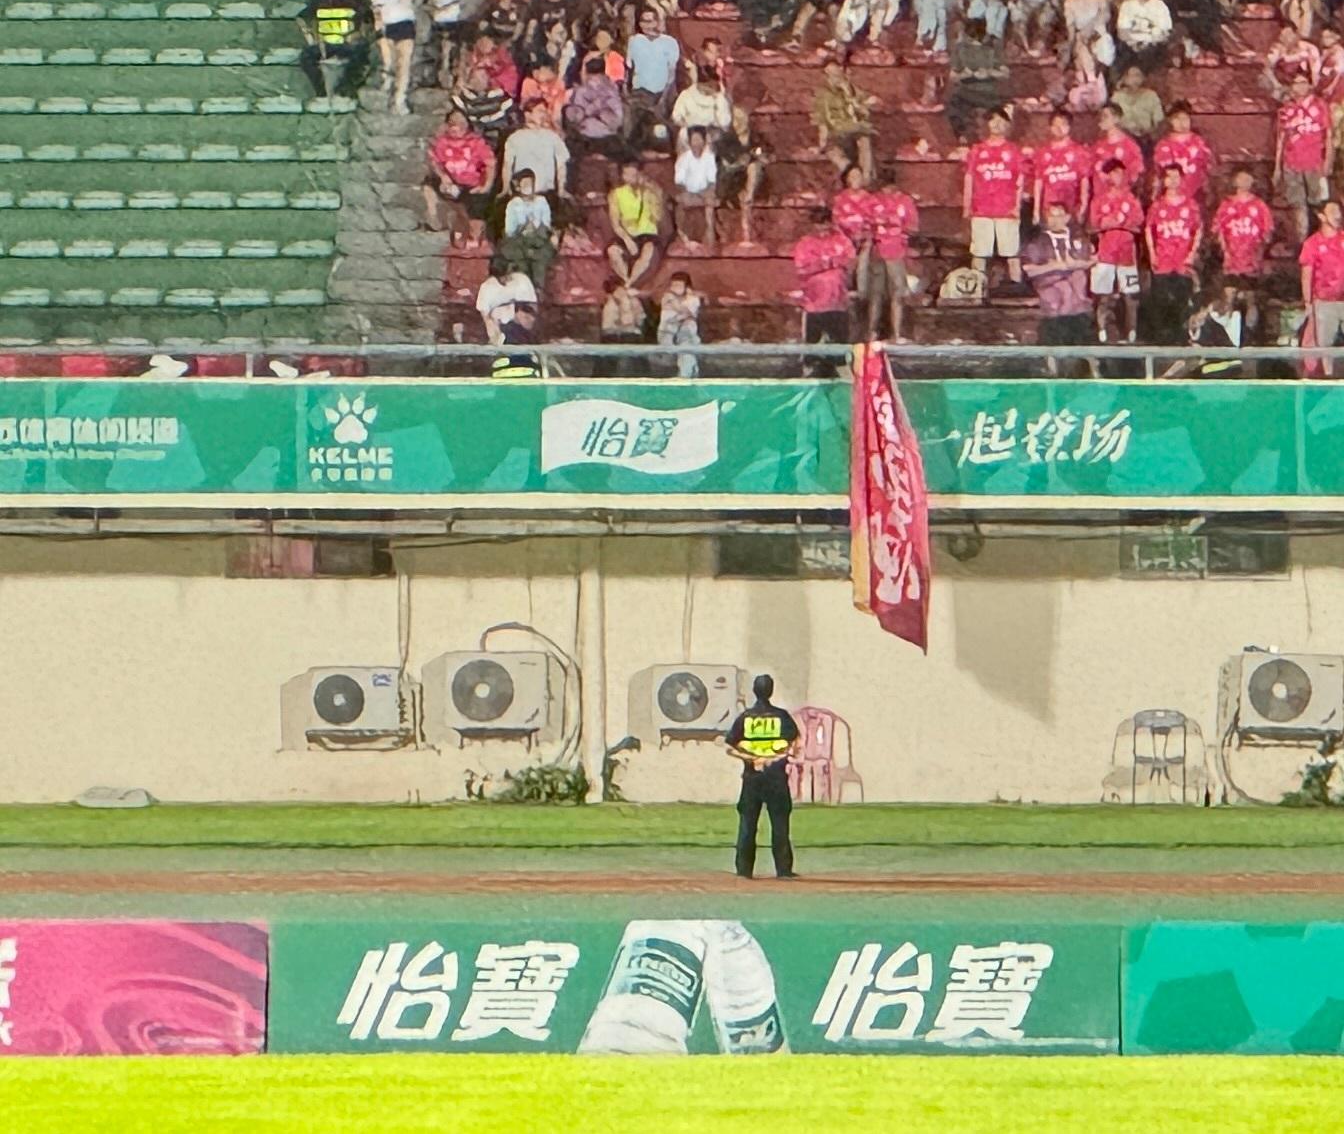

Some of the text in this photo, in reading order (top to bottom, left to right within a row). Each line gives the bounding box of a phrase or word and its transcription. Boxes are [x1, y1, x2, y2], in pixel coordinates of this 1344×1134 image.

[309, 447, 393, 465] KELME
[336, 940, 582, 1042] 怡寶
[812, 940, 1055, 1044] 怡寶
